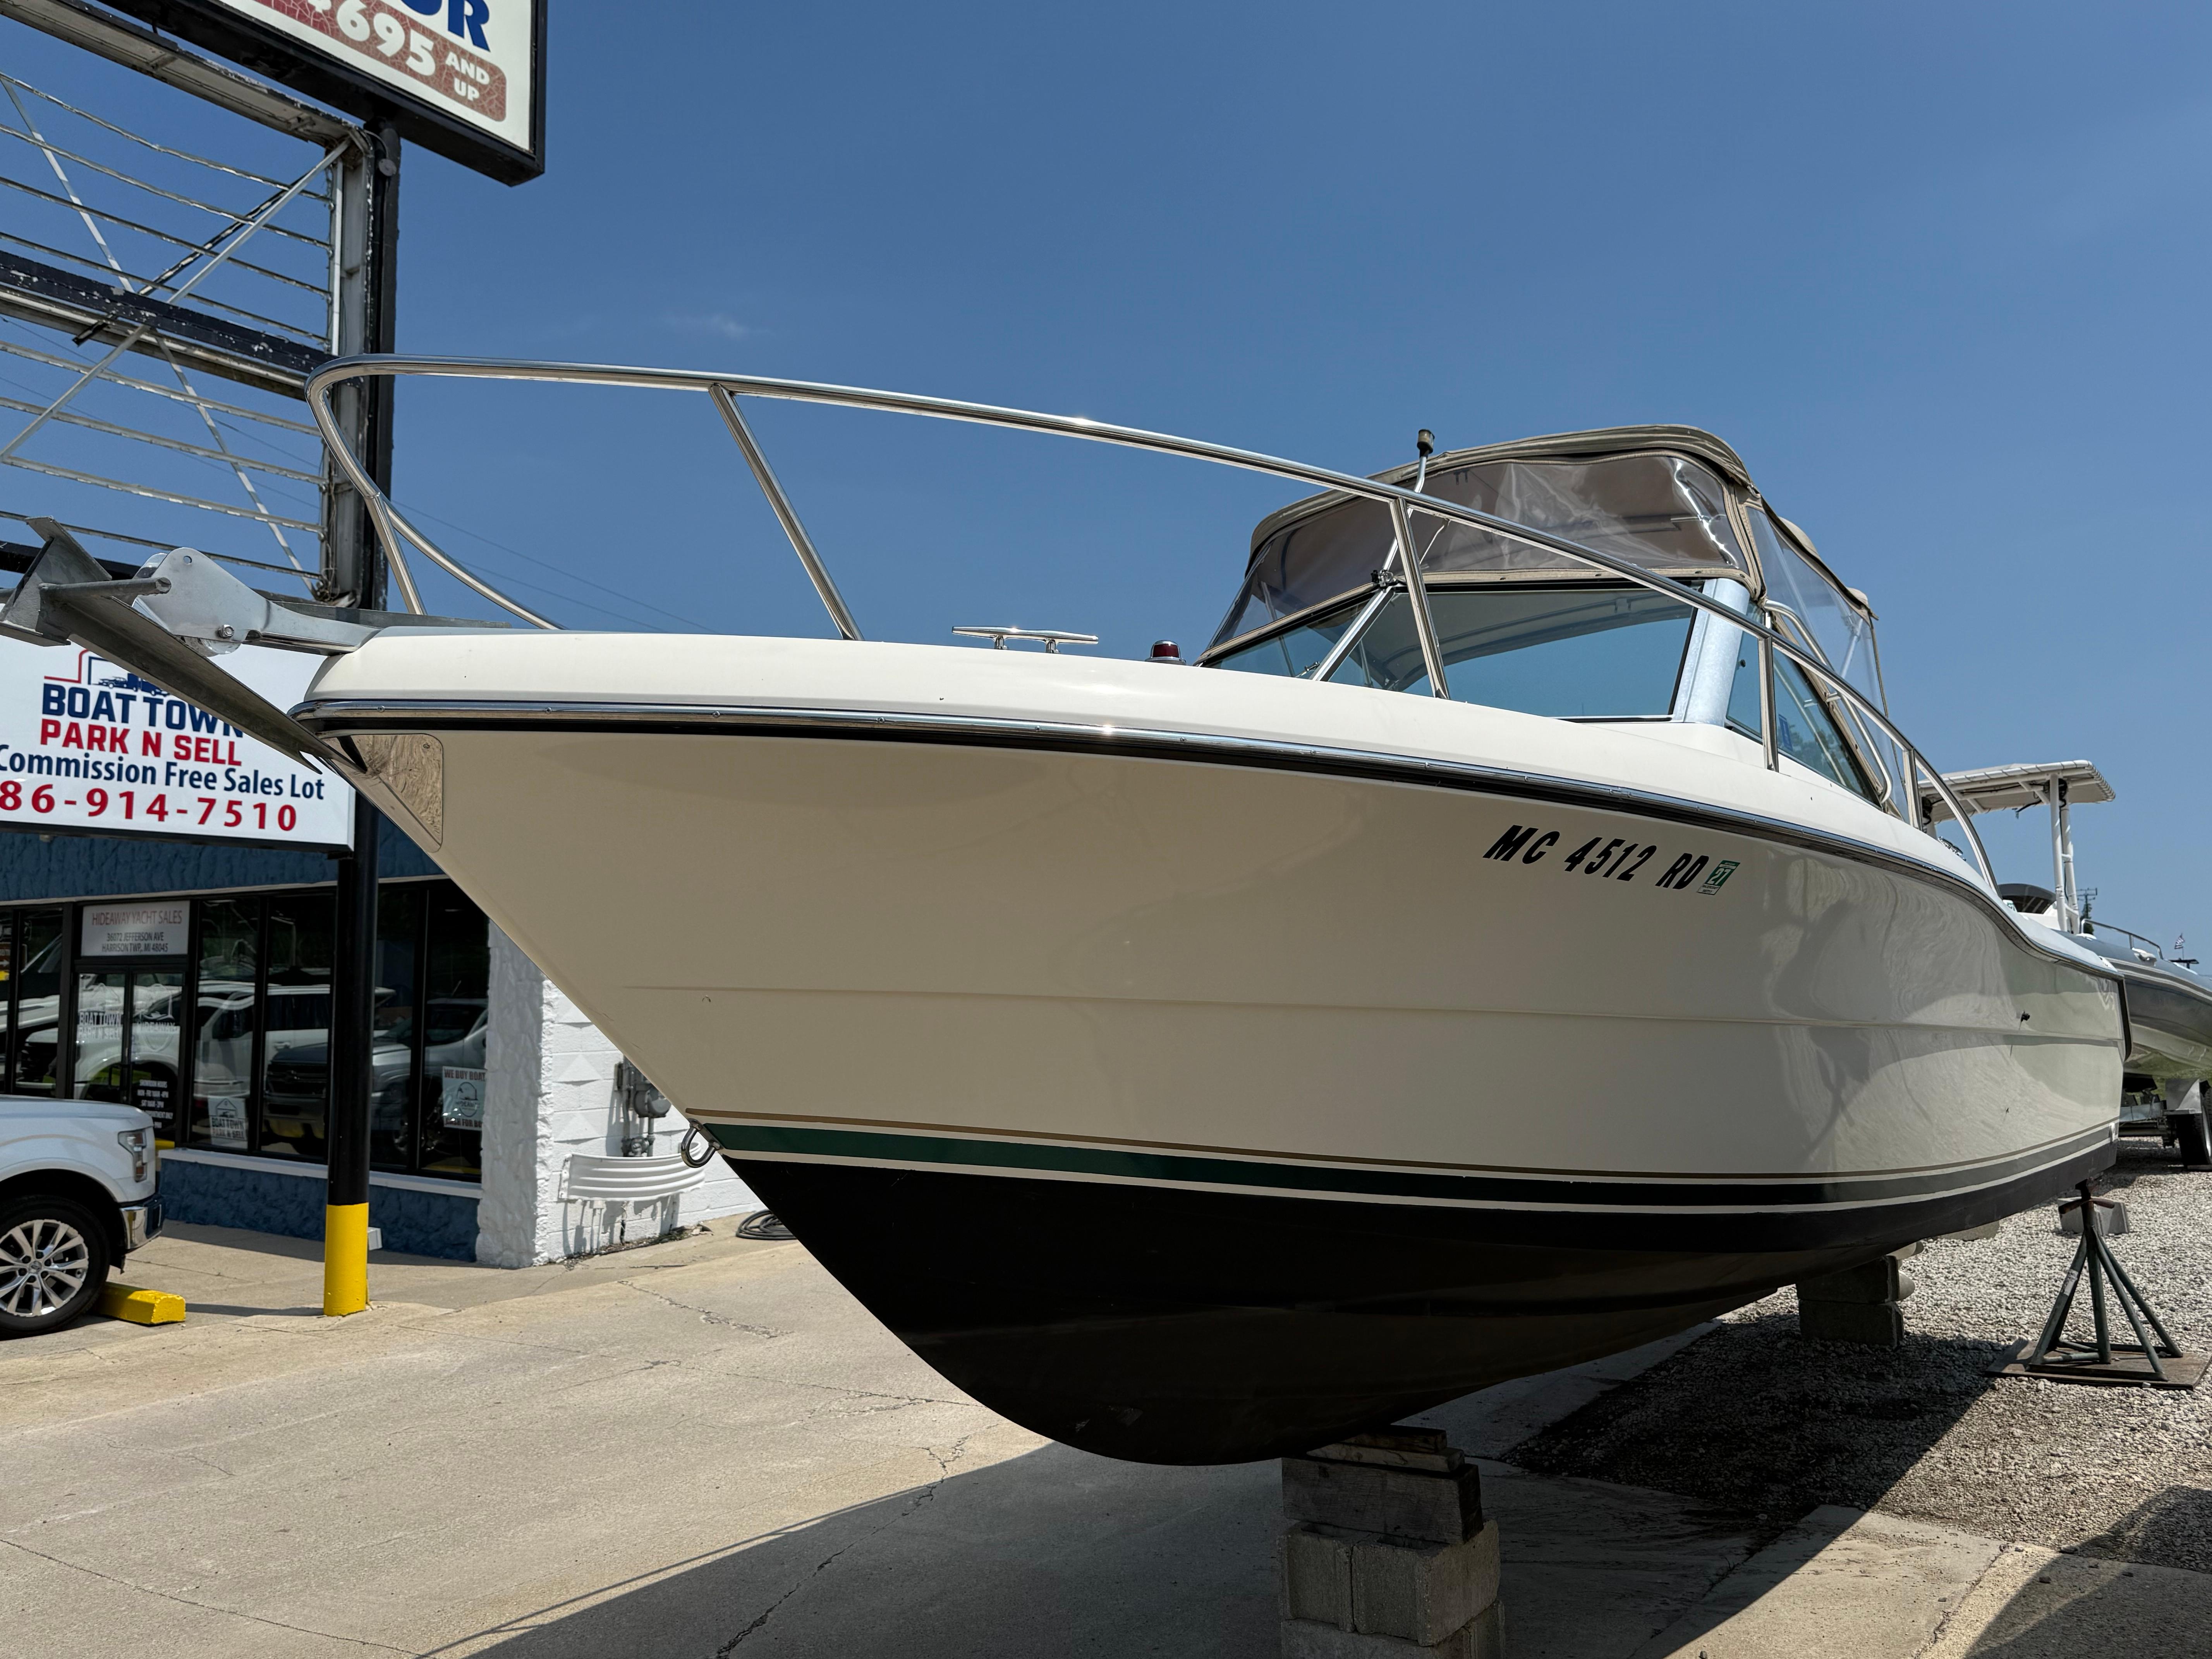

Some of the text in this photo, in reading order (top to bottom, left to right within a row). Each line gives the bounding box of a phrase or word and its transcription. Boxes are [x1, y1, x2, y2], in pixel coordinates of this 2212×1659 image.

[446, 52, 490, 85] AND
[453, 77, 480, 101] UP
[42, 683, 137, 723] BOAT
[41, 718, 242, 766] PARK N SELL
[165, 761, 217, 790] Free
[224, 768, 283, 796] Sales
[290, 774, 325, 800] Lot
[1483, 825, 1709, 890] MC 4512 RD
[1707, 868, 1731, 885] 27
[92, 910, 183, 925] HIDEAWAY YACHT SALES
[107, 932, 164, 941] 36072 JEFFERSON AVE
[102, 943, 129, 952] HARRISON
[144, 943, 151, 951] MI
[152, 943, 168, 952] 48045
[79, 1012, 122, 1025] BOAT TOWN
[444, 1069, 454, 1079] WE
[455, 1070, 468, 1080] BUY
[212, 1117, 244, 1130] BOAT TOWN
